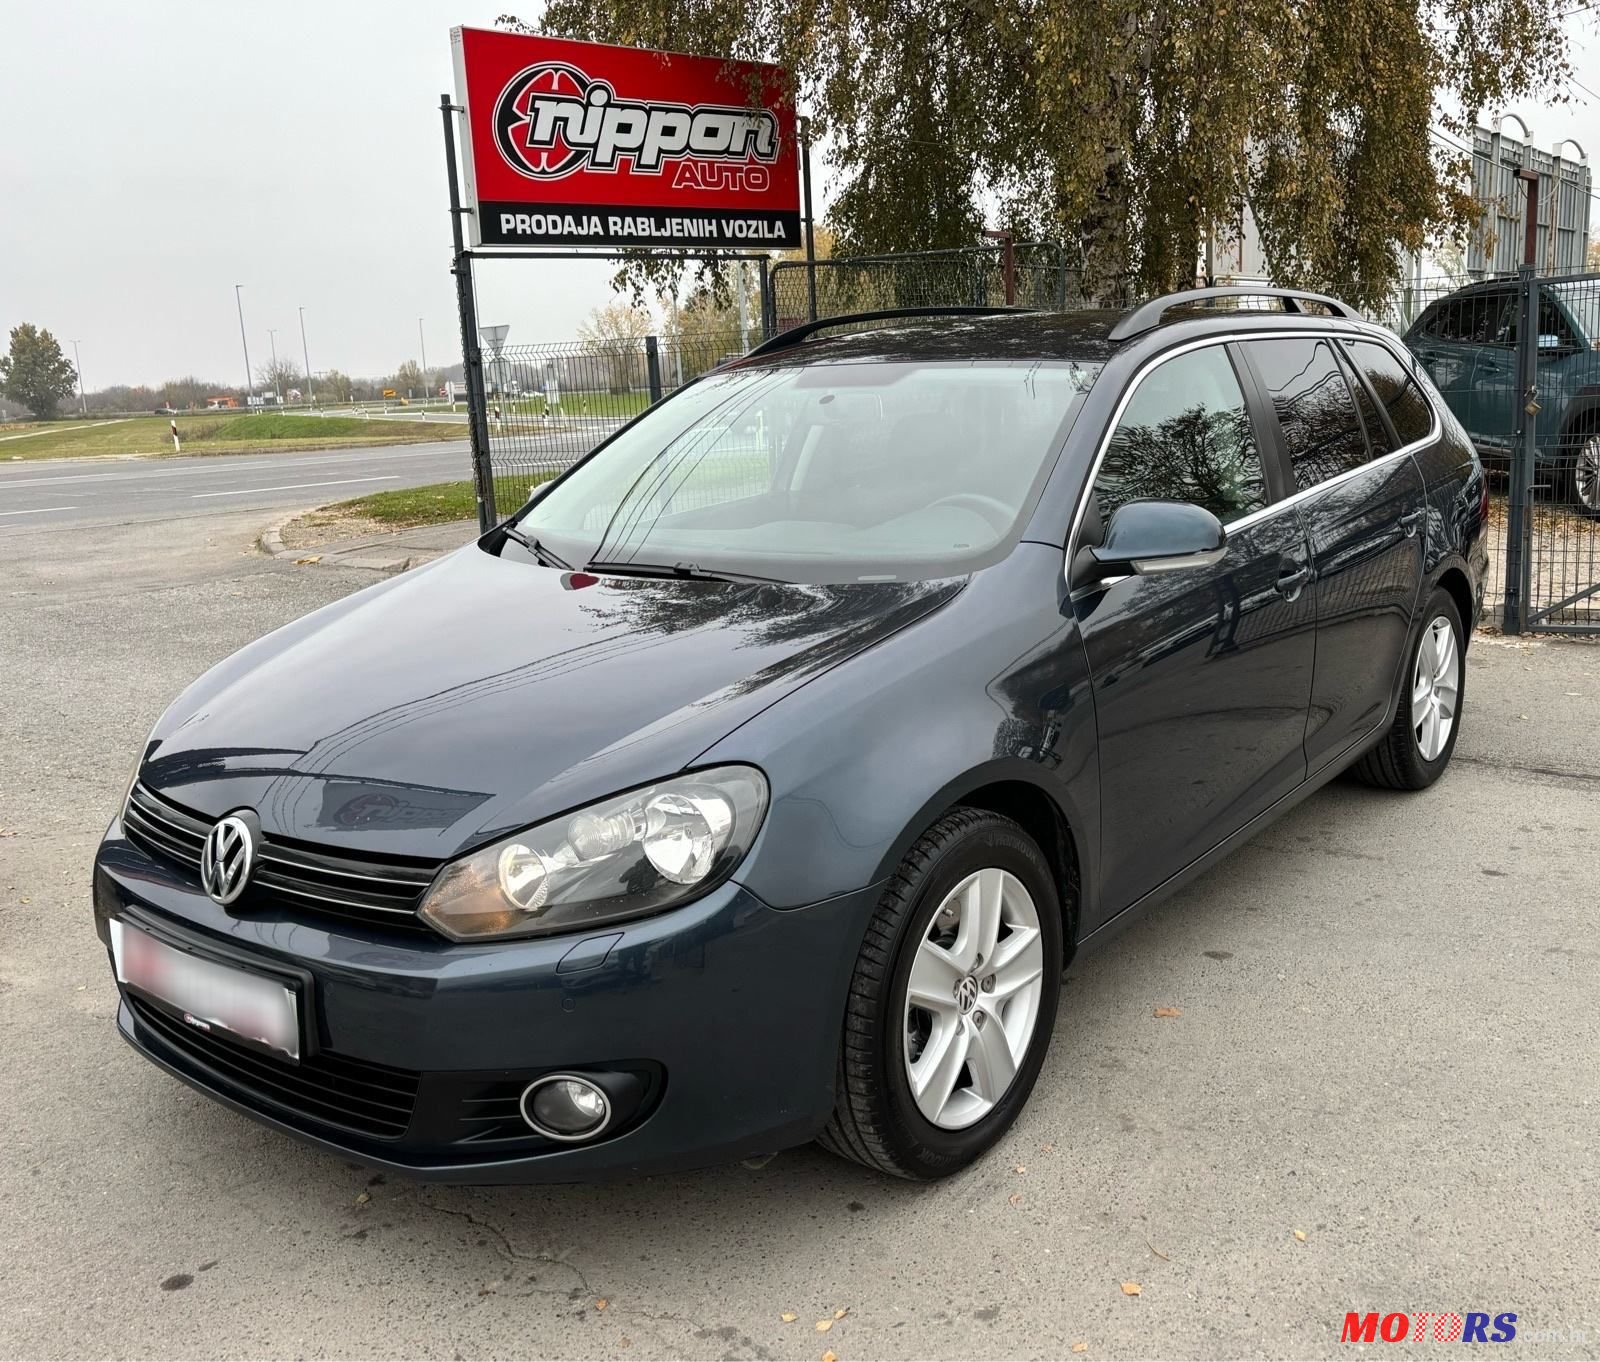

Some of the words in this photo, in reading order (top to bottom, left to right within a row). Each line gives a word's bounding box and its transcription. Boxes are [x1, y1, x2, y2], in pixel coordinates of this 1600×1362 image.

[530, 86, 775, 168] nippon
[672, 161, 770, 192] AUTO
[500, 213, 604, 236] PRODAJA
[608, 216, 717, 239] RABLJENIH
[724, 218, 786, 240] VOZILA
